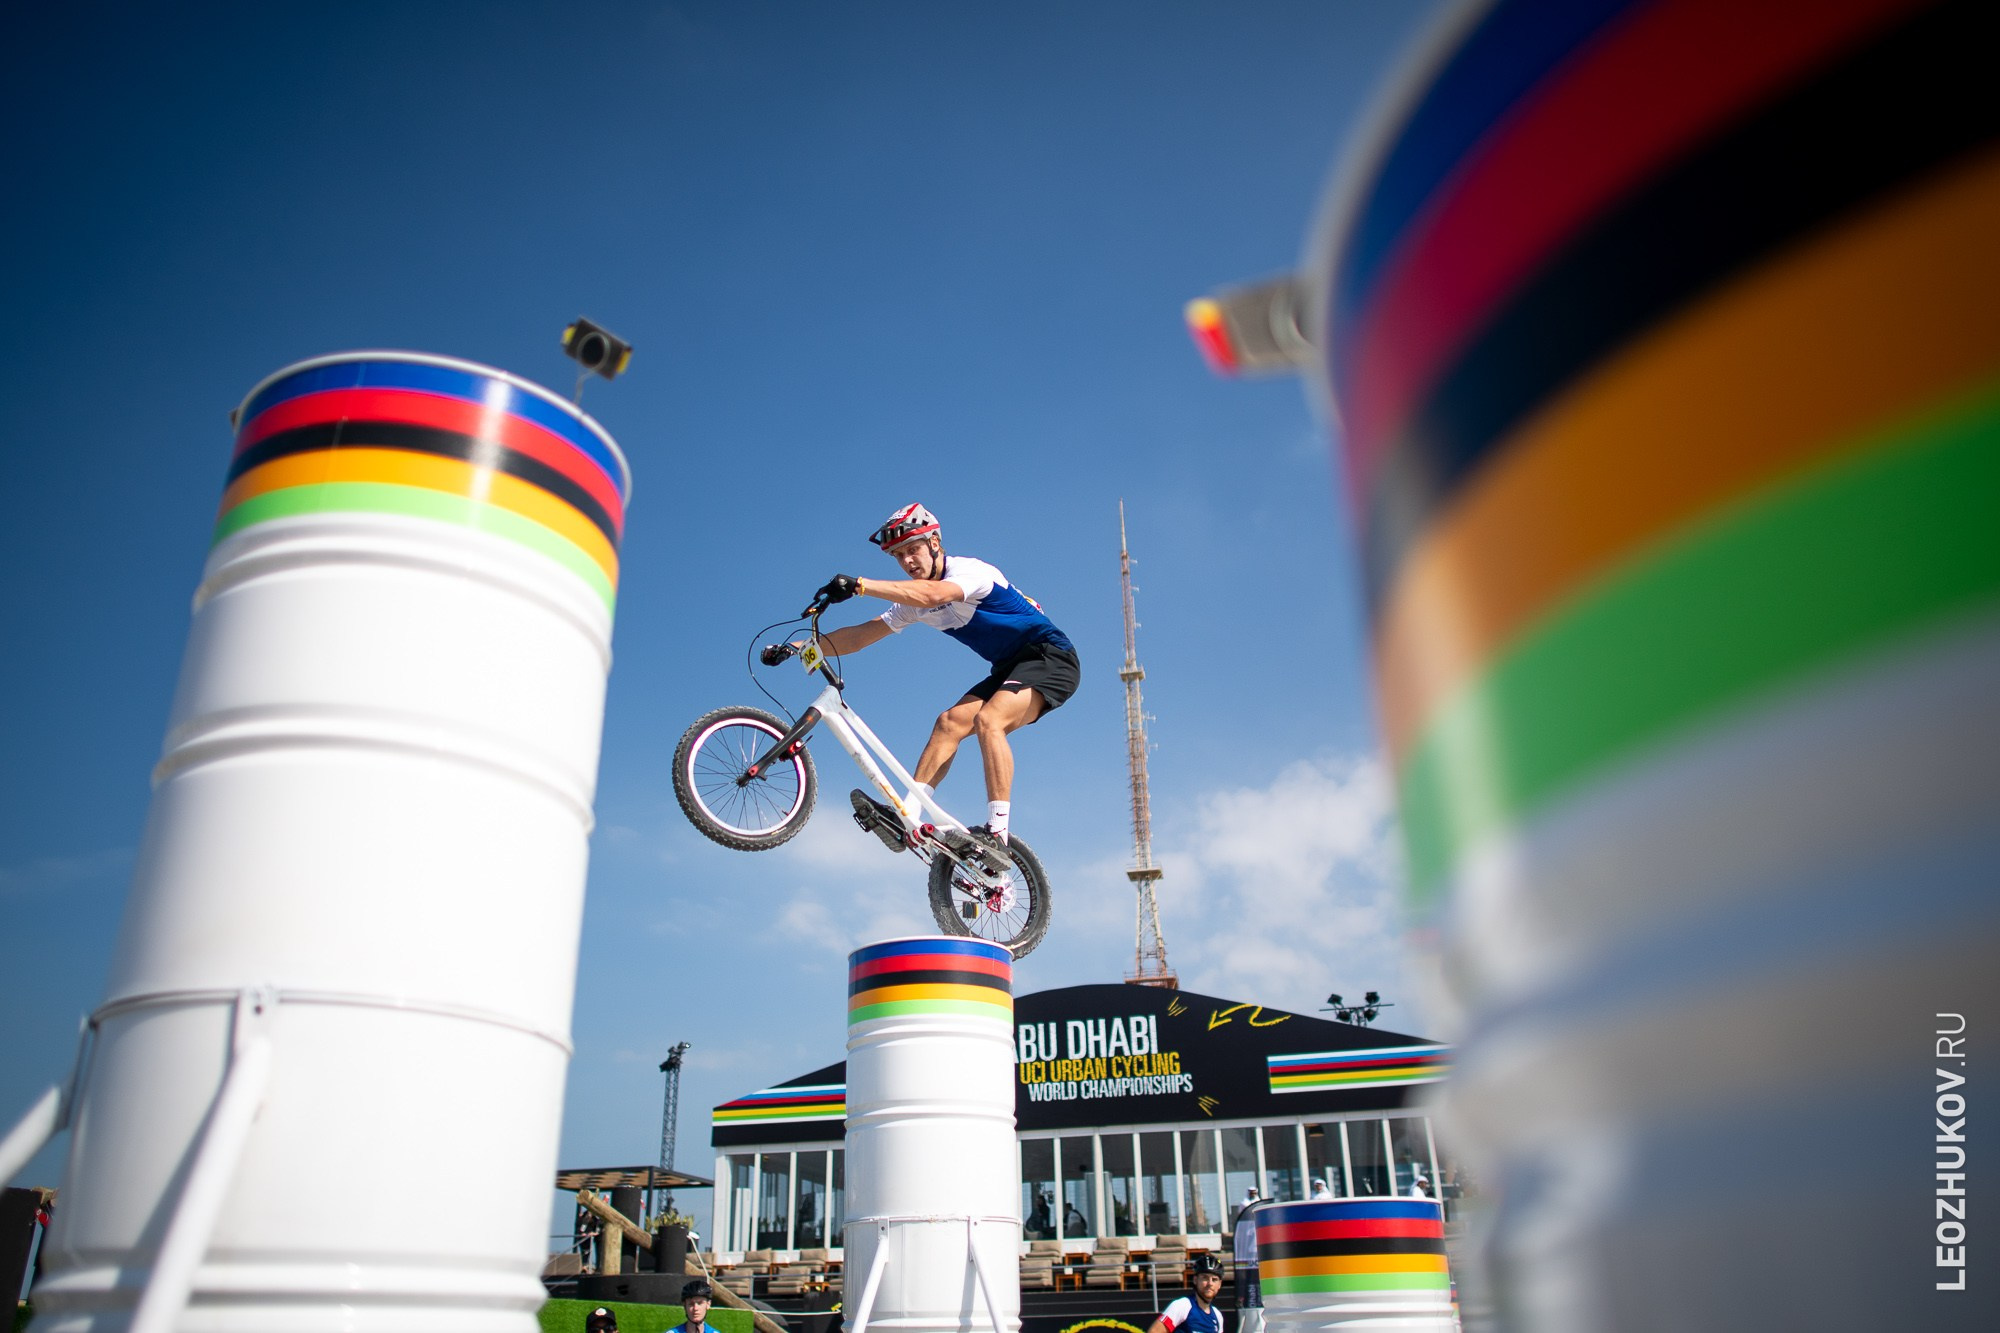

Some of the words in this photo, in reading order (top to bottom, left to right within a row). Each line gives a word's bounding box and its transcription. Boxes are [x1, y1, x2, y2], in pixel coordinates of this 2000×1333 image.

[1013, 1022, 1058, 1064] BU
[1066, 1014, 1158, 1060] DHABI
[1020, 1061, 1046, 1084] UCI
[1050, 1056, 1107, 1083] URBAN
[1111, 1051, 1181, 1079] CYCLING
[1028, 1081, 1077, 1102] WORLD
[1080, 1073, 1194, 1100] CHAMPIONSHIPS
